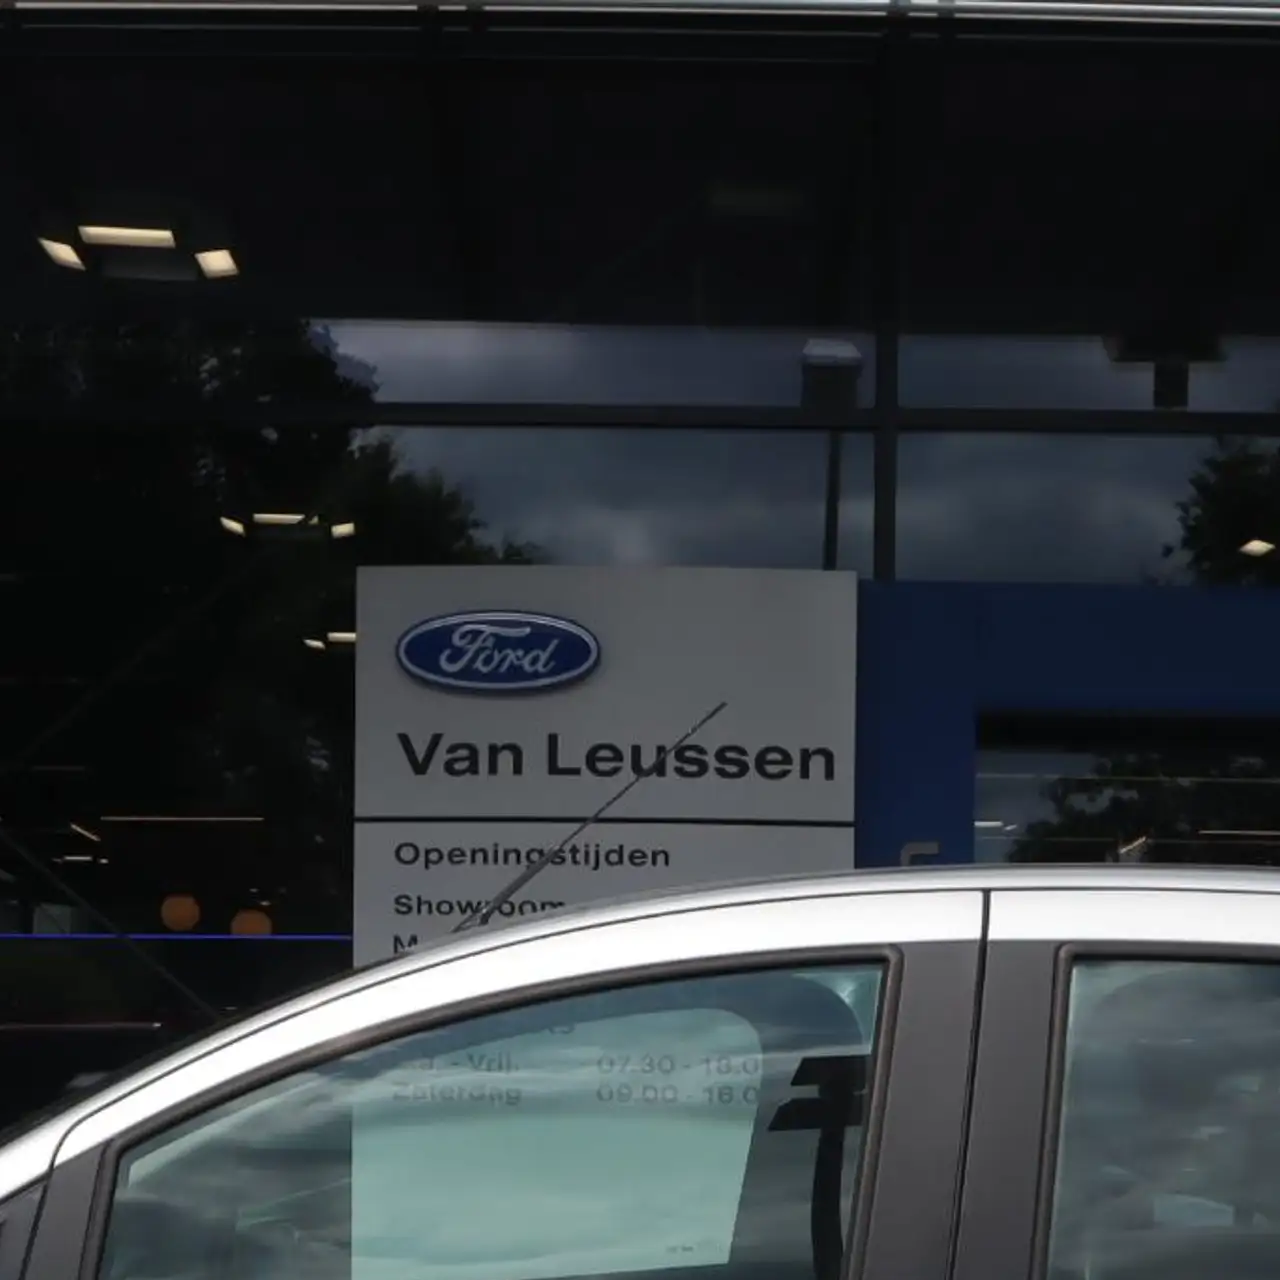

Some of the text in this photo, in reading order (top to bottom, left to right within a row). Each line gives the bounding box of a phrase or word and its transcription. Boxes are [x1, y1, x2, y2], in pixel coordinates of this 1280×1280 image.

[439, 624, 559, 674] Ford
[397, 732, 836, 781] Van Leussen
[394, 841, 671, 870] Openingstijden
